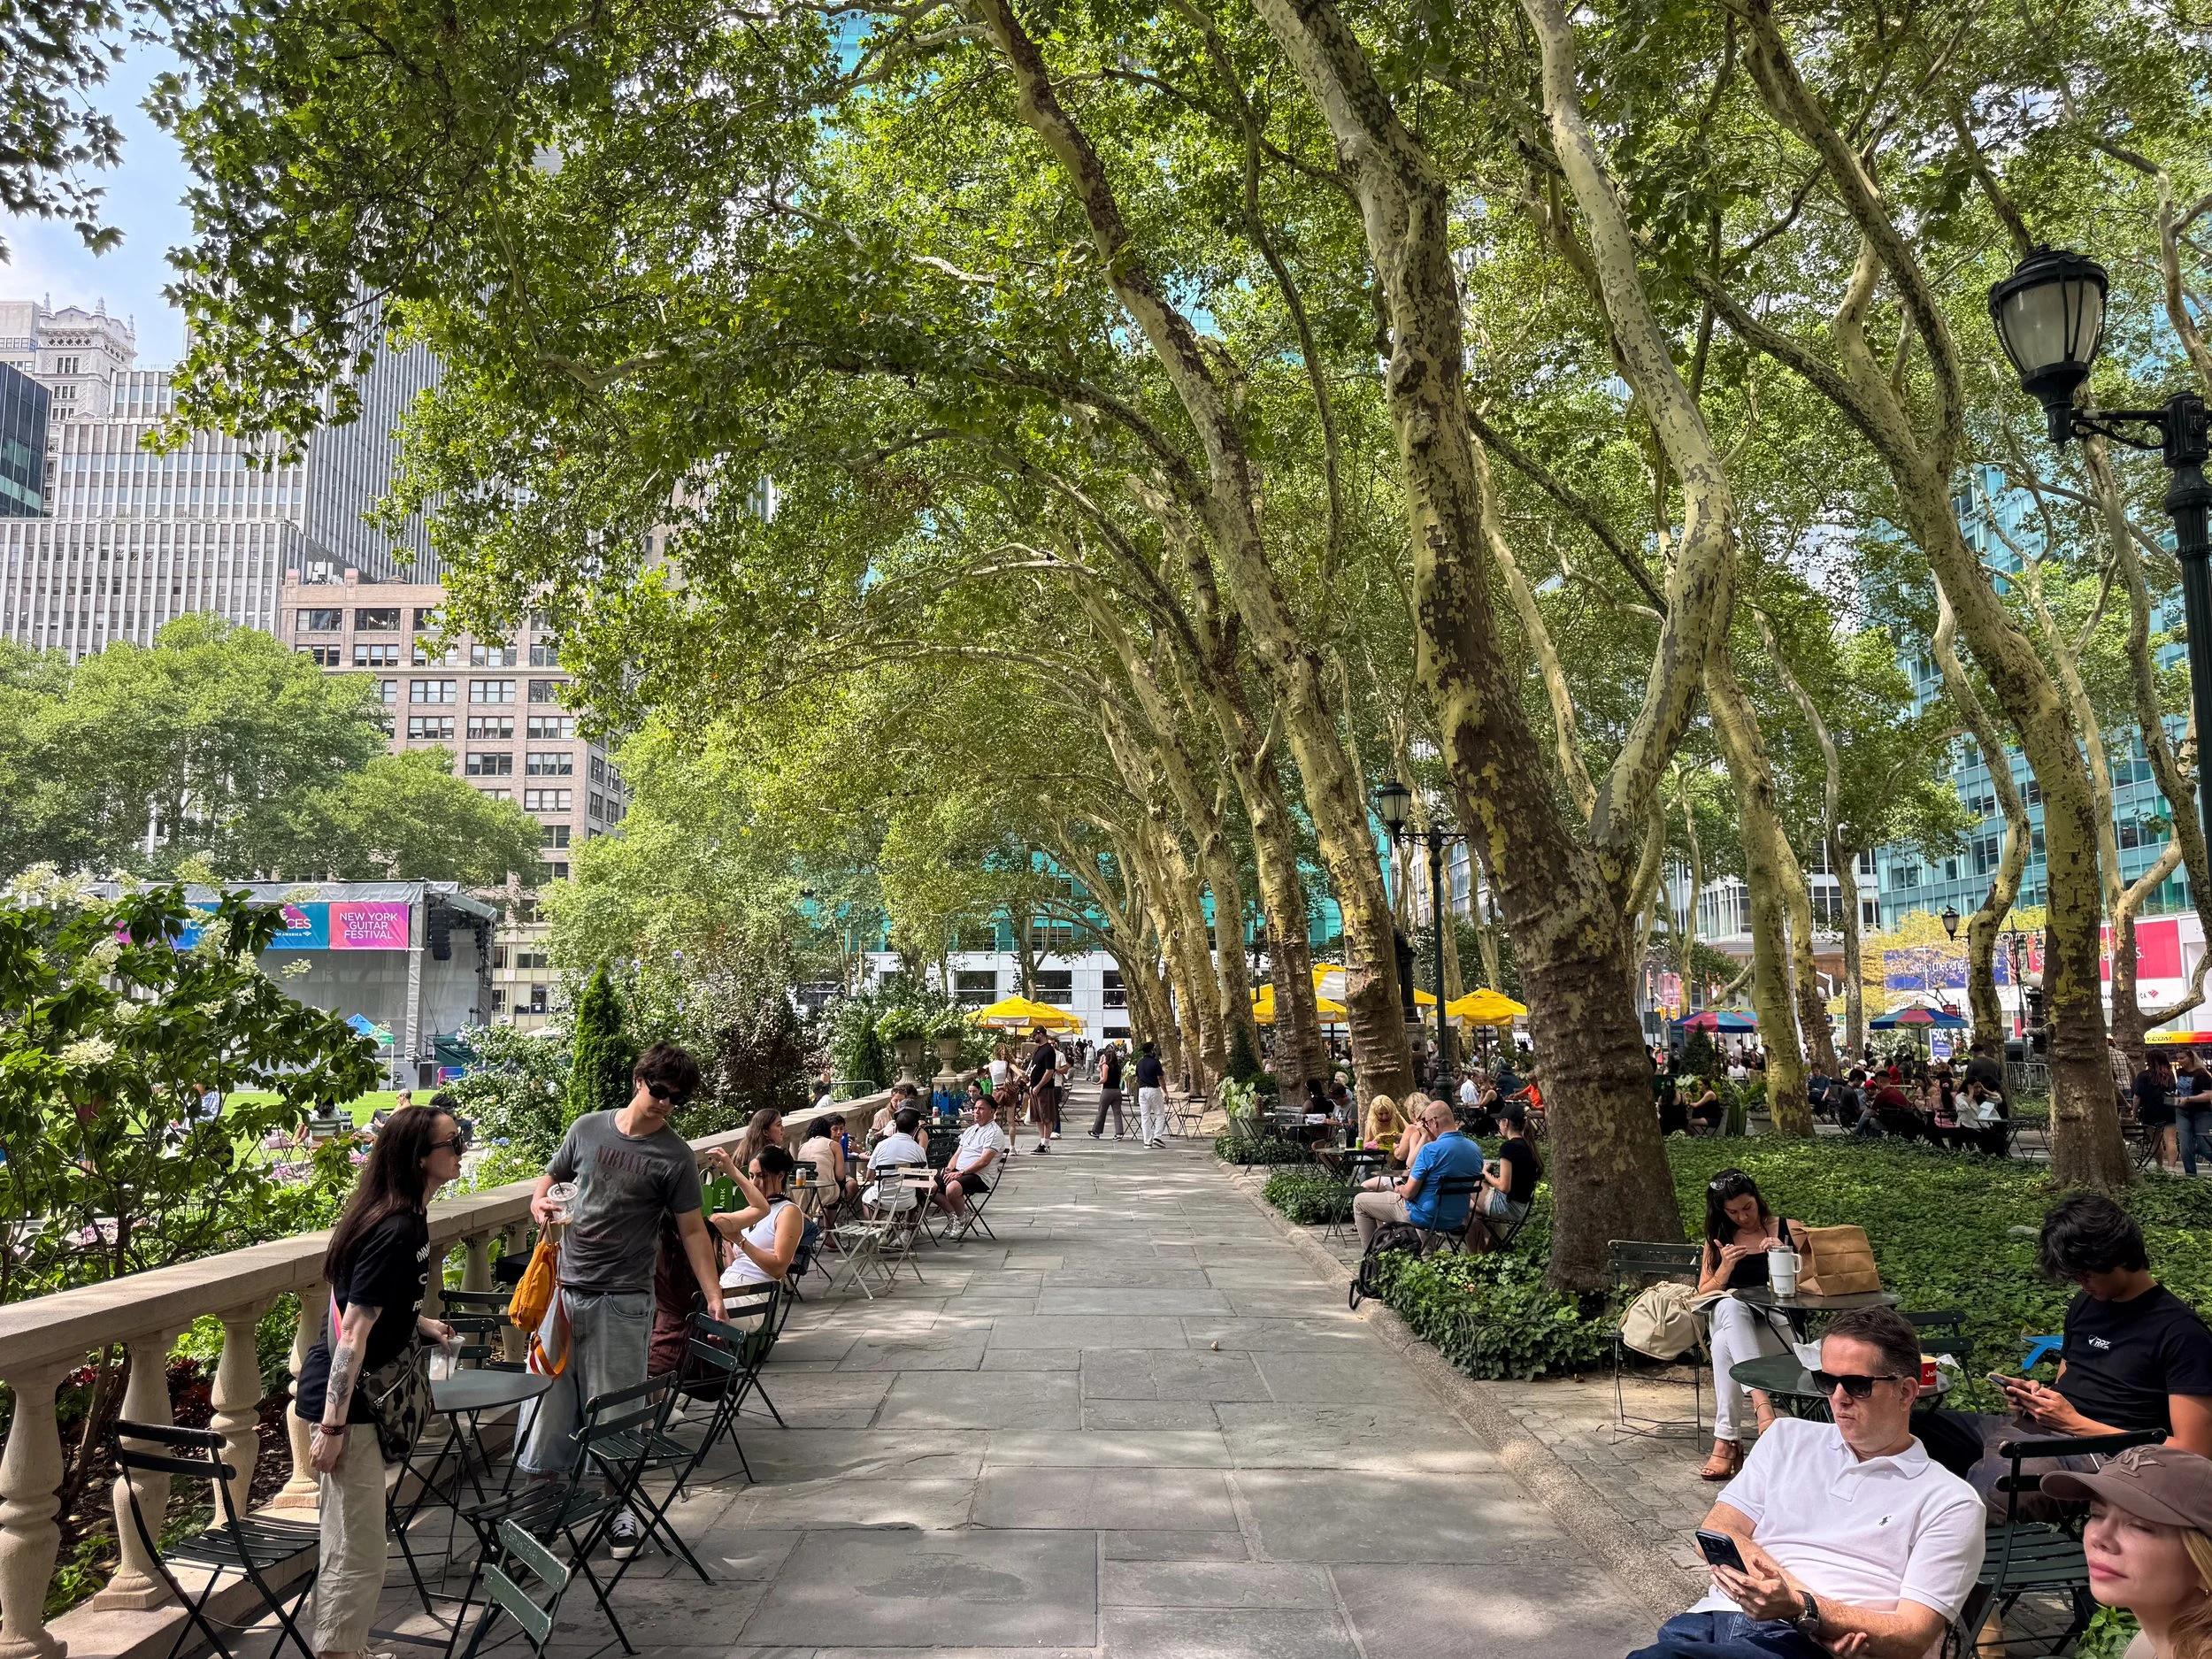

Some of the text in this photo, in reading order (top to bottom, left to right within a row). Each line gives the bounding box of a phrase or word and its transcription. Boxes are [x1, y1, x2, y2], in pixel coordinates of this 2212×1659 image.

[340, 912, 398, 921] NEW YORK
[349, 921, 388, 930] GUITAR
[344, 930, 393, 939] FESTIVAL
[597, 1145, 652, 1176] NIRVANA
